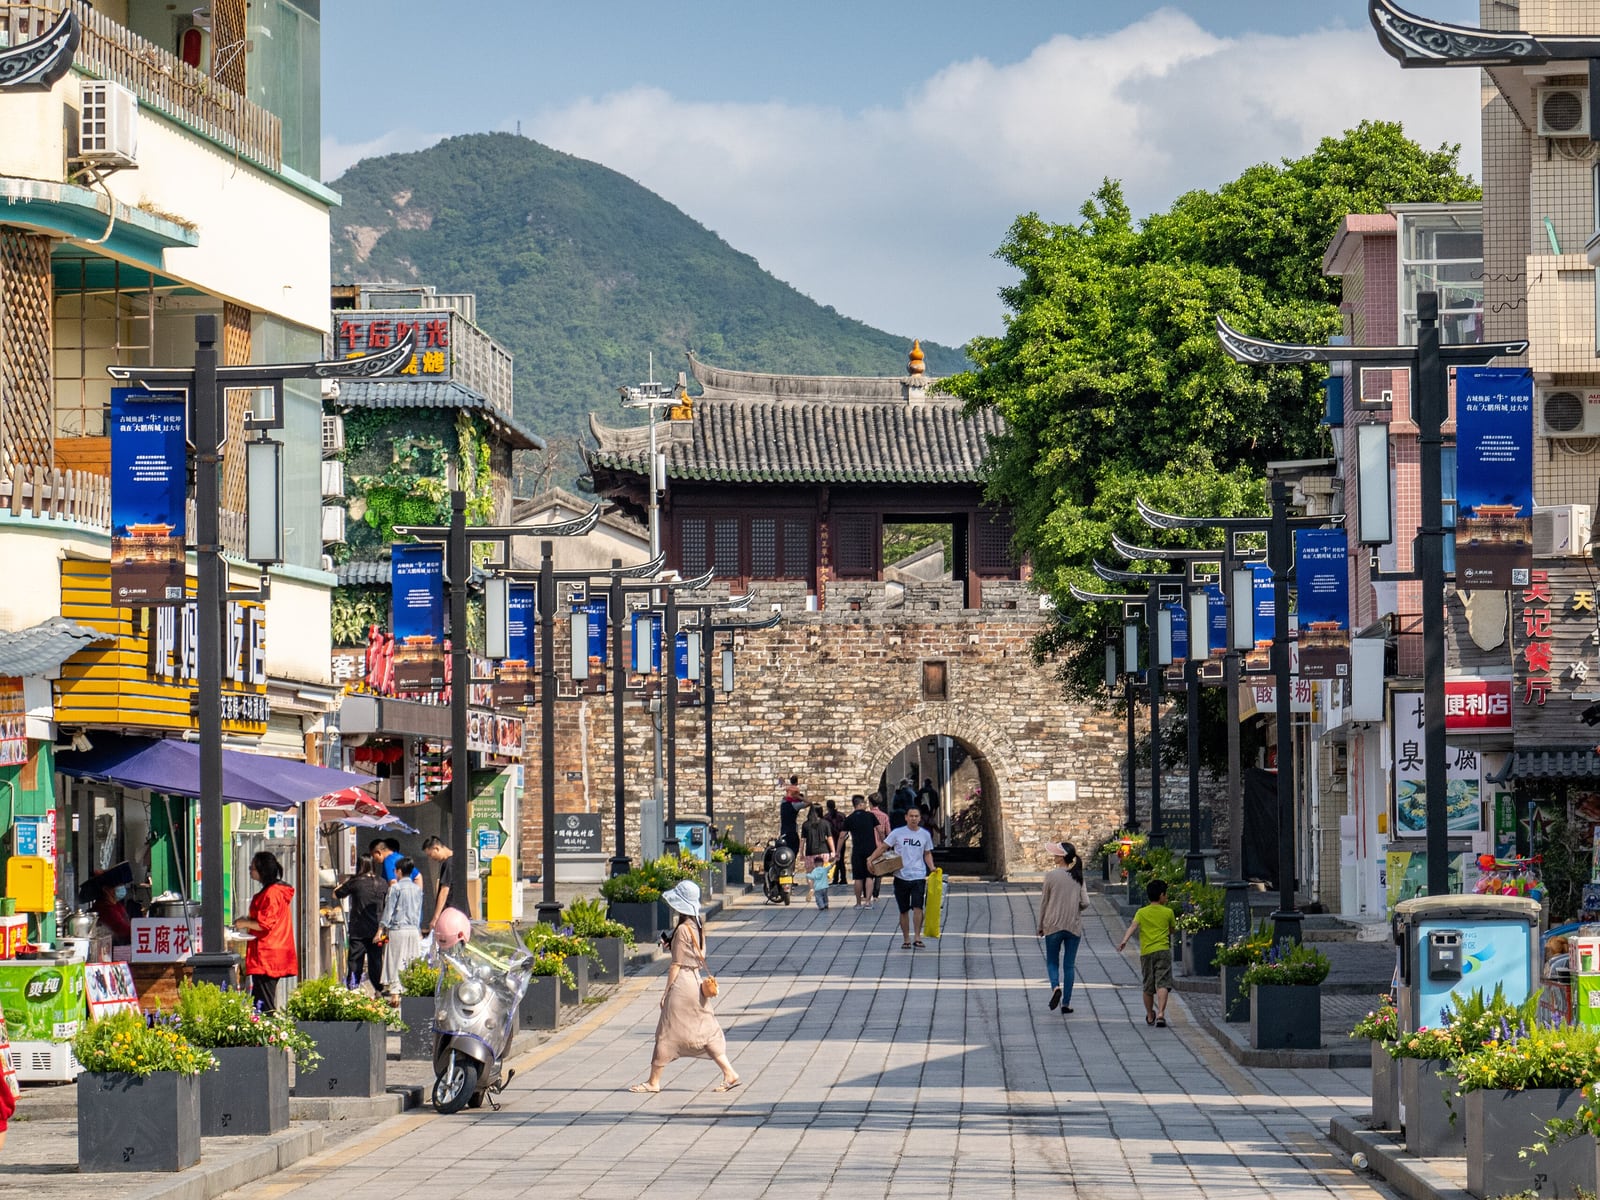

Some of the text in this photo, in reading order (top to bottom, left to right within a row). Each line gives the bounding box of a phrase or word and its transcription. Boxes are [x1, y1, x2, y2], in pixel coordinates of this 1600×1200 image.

[1256, 679, 1311, 704] 酸粉
[1445, 693, 1508, 715] 便利店
[1398, 739, 1477, 771] 臭腐
[903, 838, 922, 847] FILA
[136, 925, 190, 955] 豆腐花
